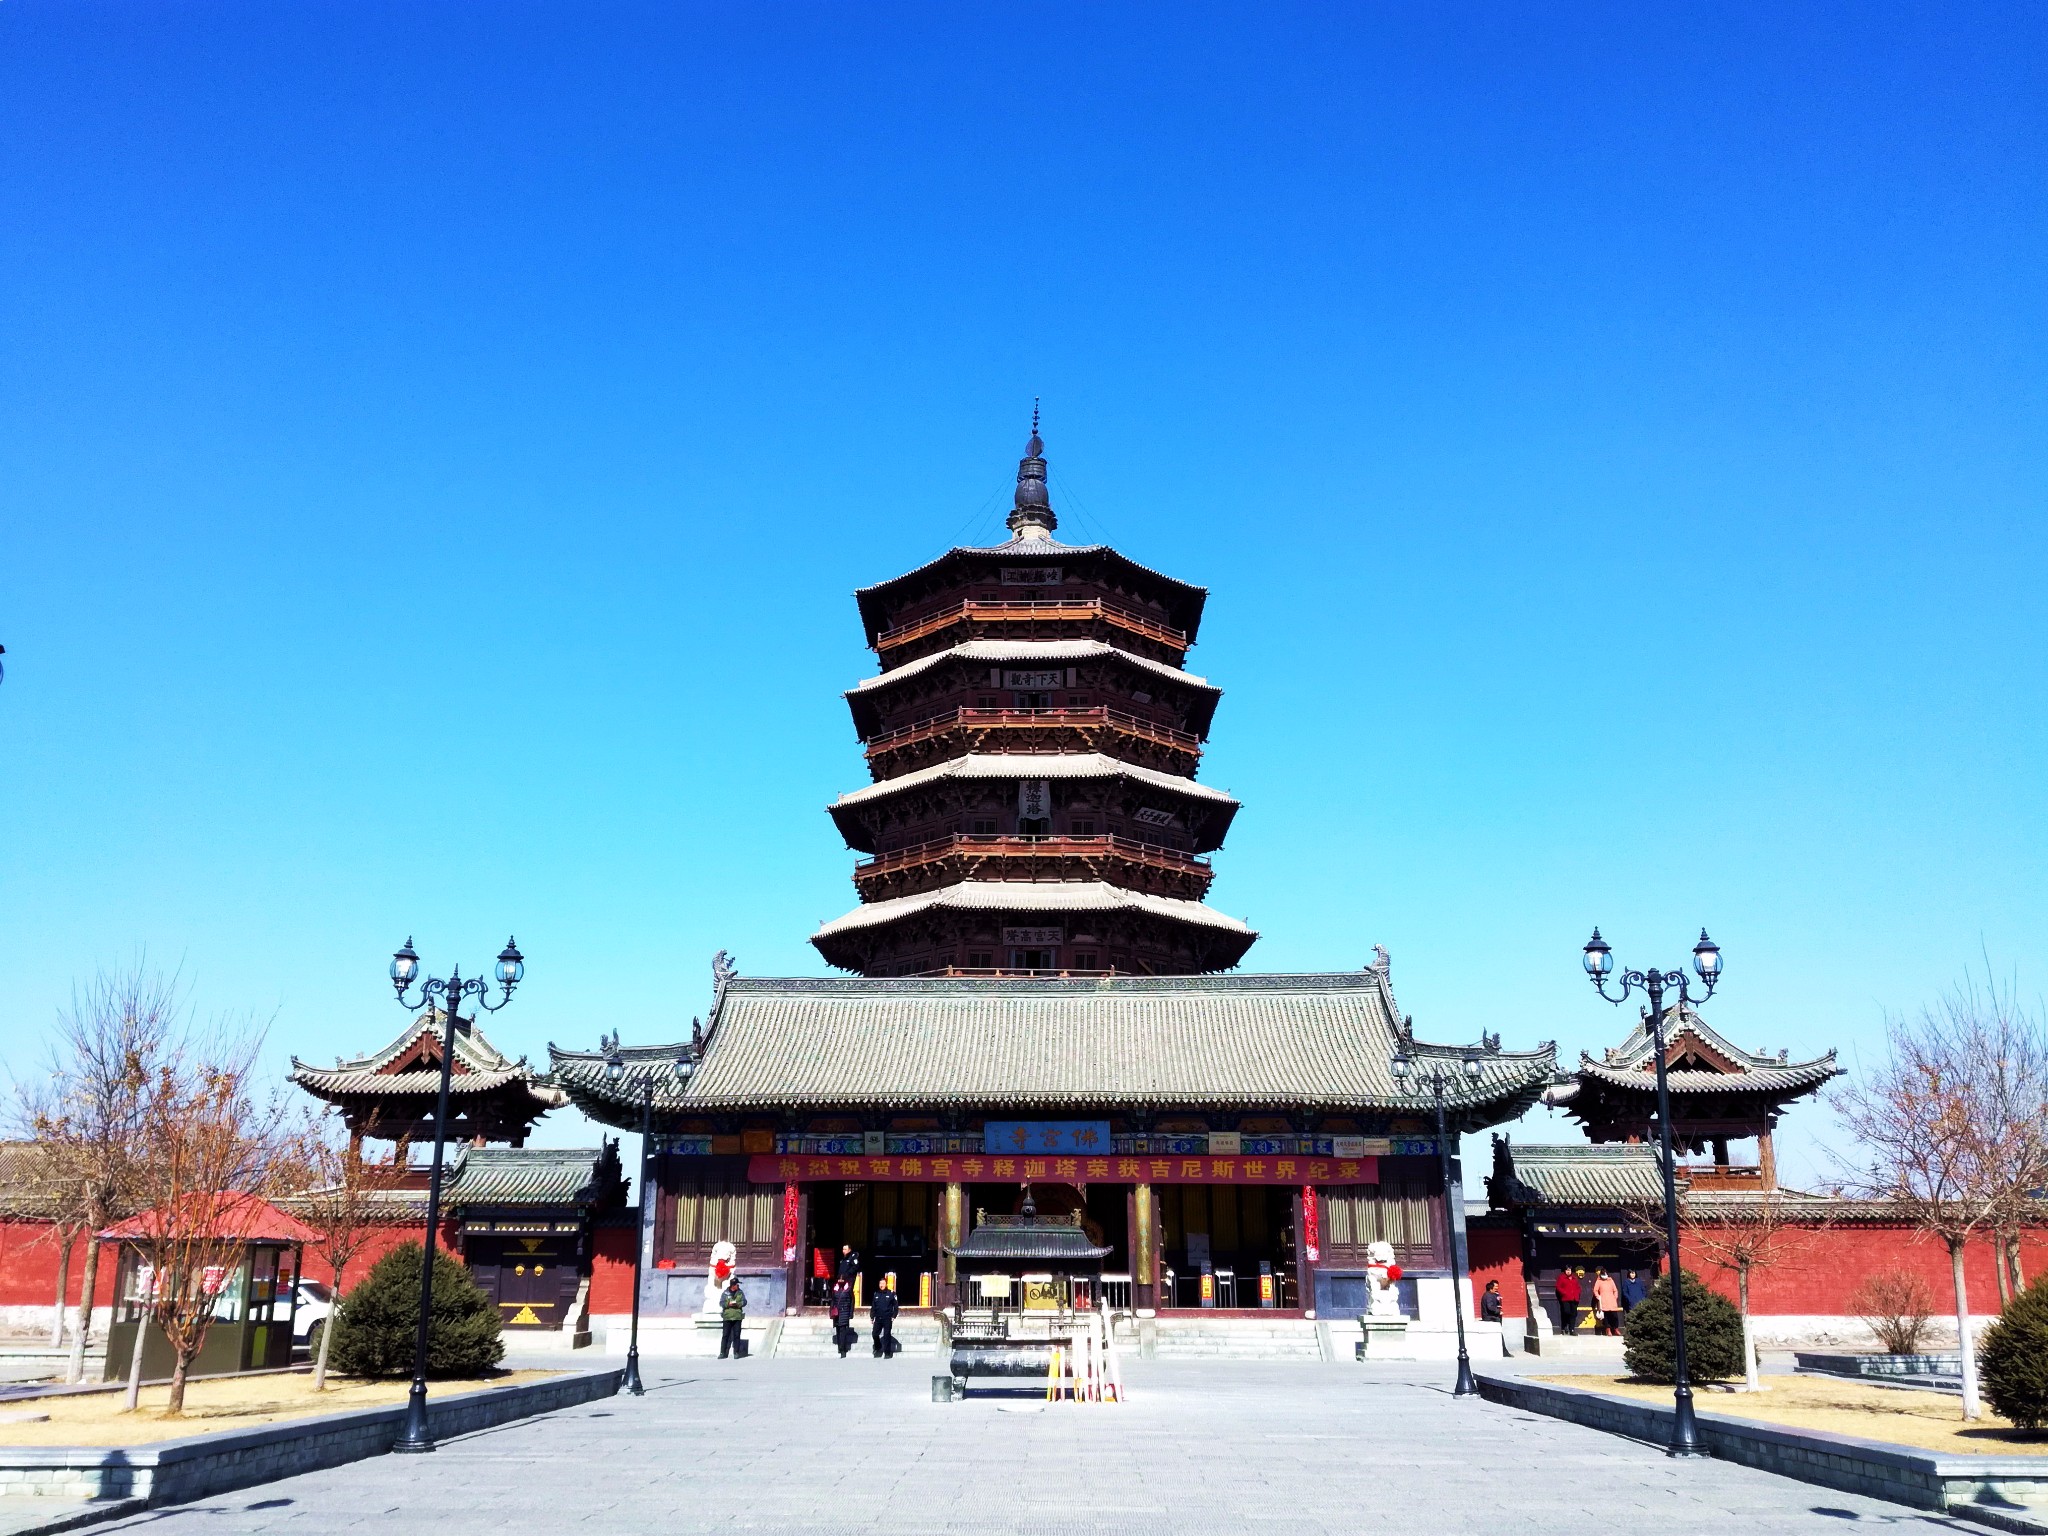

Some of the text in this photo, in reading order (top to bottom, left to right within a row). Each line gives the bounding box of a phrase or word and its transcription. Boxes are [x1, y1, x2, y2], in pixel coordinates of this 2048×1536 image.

[778, 1158, 1361, 1179] 热烈祝贺佛宫寺释迦塔荣获吉尼斯世界纪录
